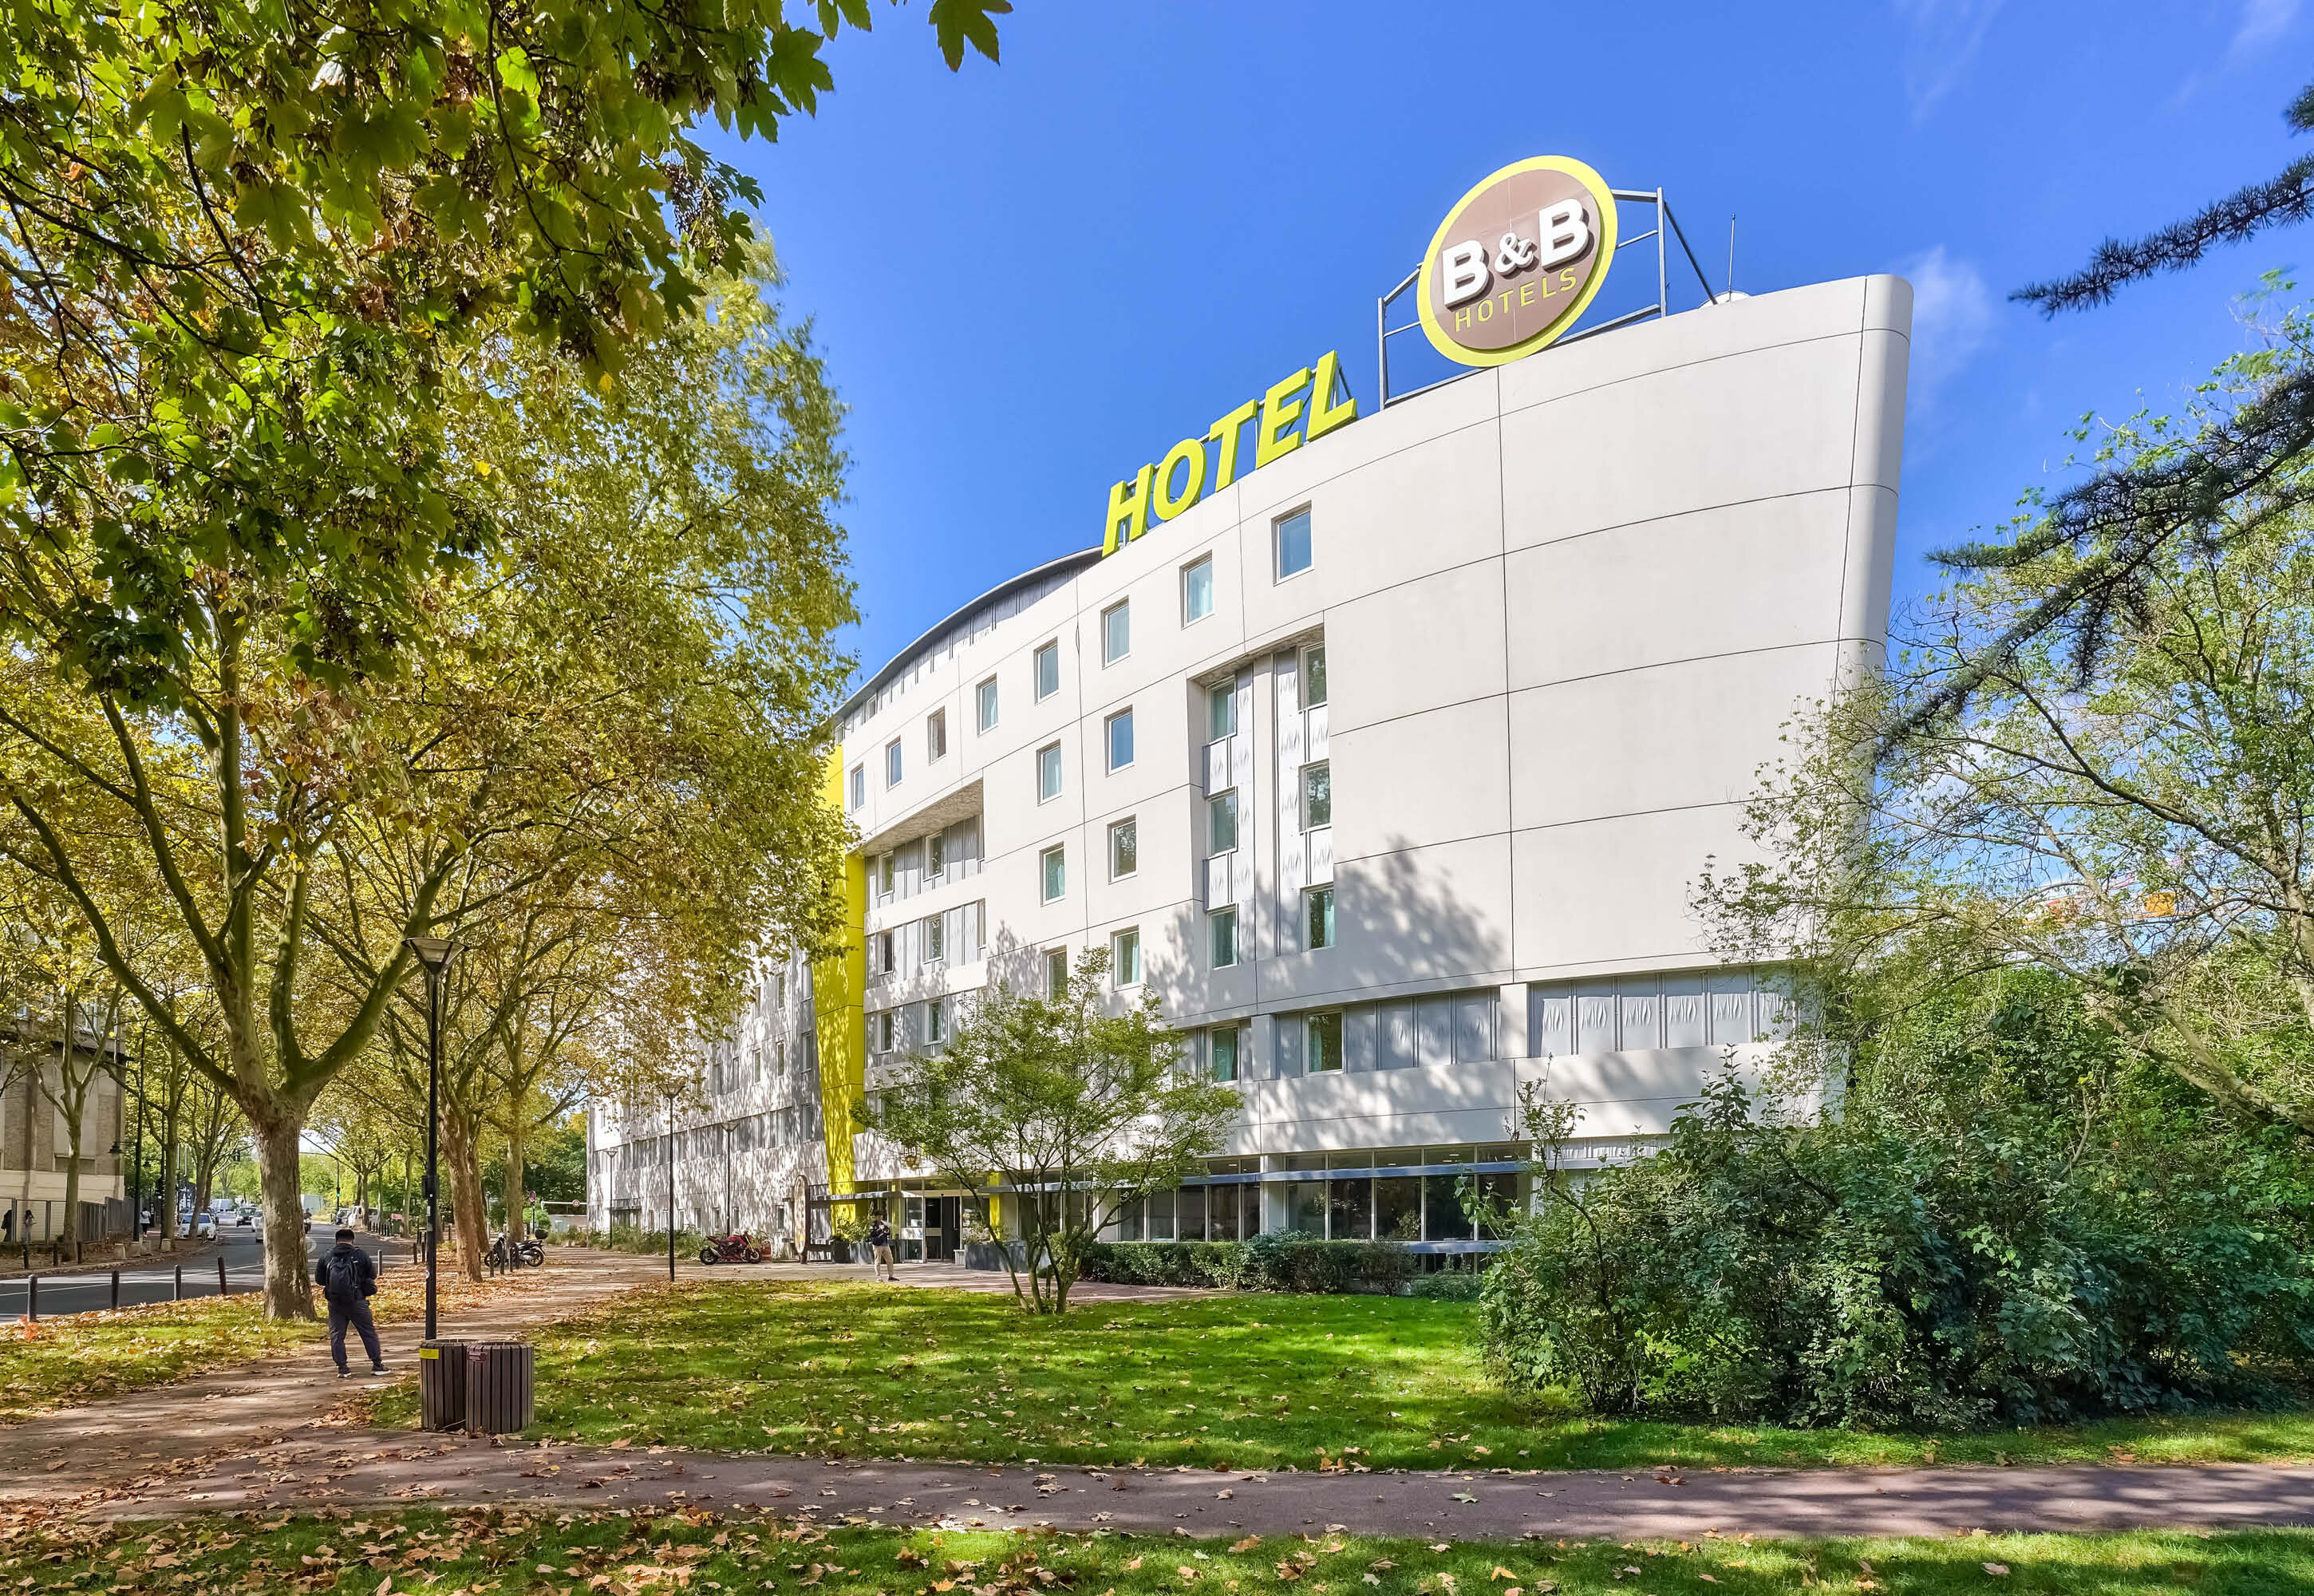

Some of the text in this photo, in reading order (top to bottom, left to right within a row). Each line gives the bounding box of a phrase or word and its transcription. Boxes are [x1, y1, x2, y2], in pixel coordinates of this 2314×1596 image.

[1442, 199, 1589, 306] B&B
[1455, 267, 1577, 332] HOTELS
[1102, 350, 1357, 558] HOTEL
